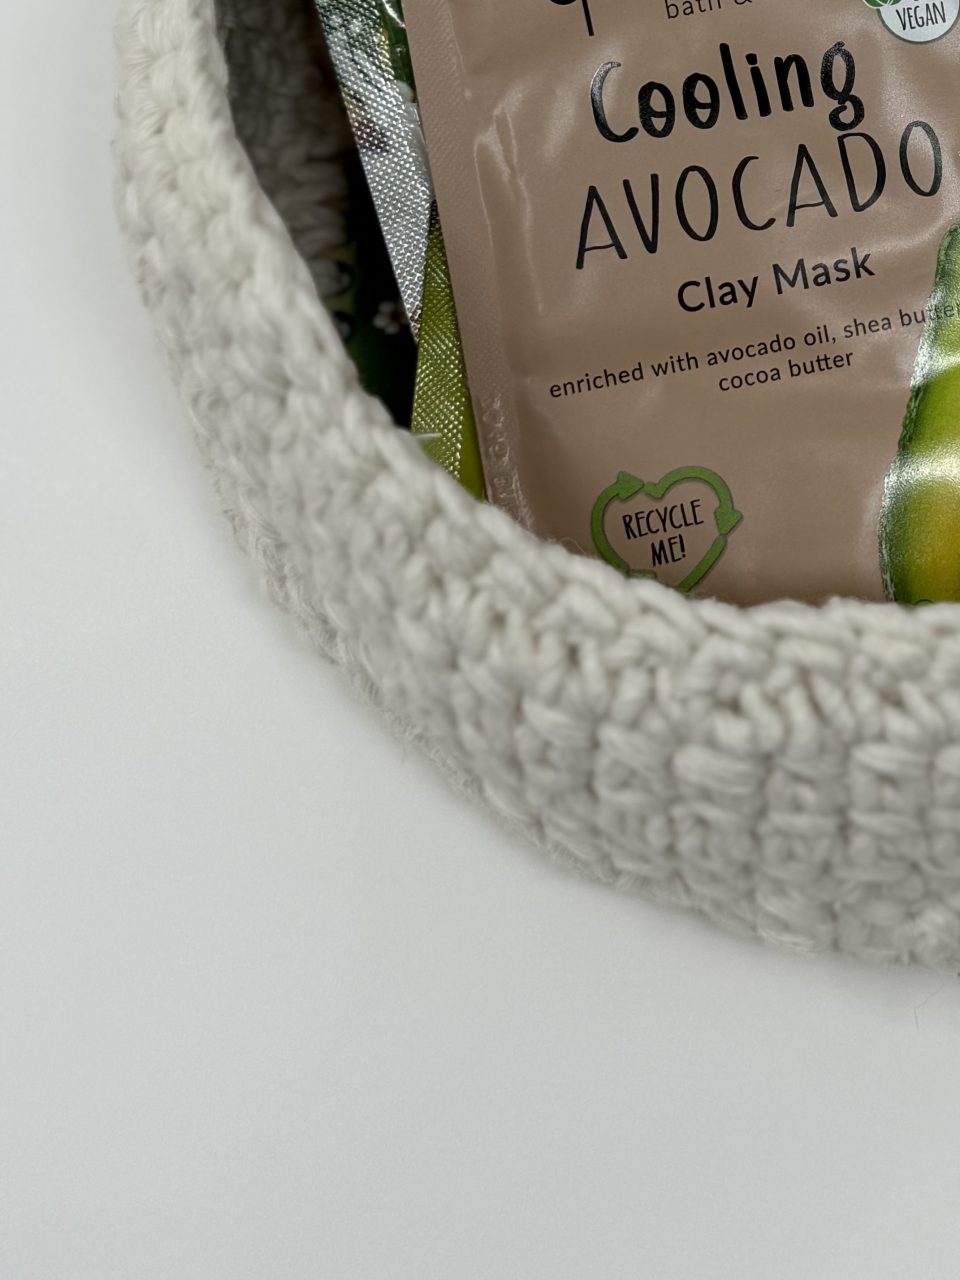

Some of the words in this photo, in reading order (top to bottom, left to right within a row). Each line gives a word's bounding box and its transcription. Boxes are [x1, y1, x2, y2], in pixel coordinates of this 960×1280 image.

[895, 0, 947, 31] VEGAN
[590, 40, 864, 144] Cooling
[576, 120, 943, 270] AVOCADO
[677, 275, 759, 313] Clay
[772, 246, 876, 296] Mask
[549, 361, 645, 398] enriched
[650, 352, 700, 377] with
[706, 333, 796, 367] avocado
[803, 324, 837, 347] oil,
[843, 317, 893, 339] shea
[718, 367, 782, 392] cocoa
[787, 351, 854, 379] butter
[621, 498, 705, 541] RECYCLE
[650, 533, 687, 567] ME!
